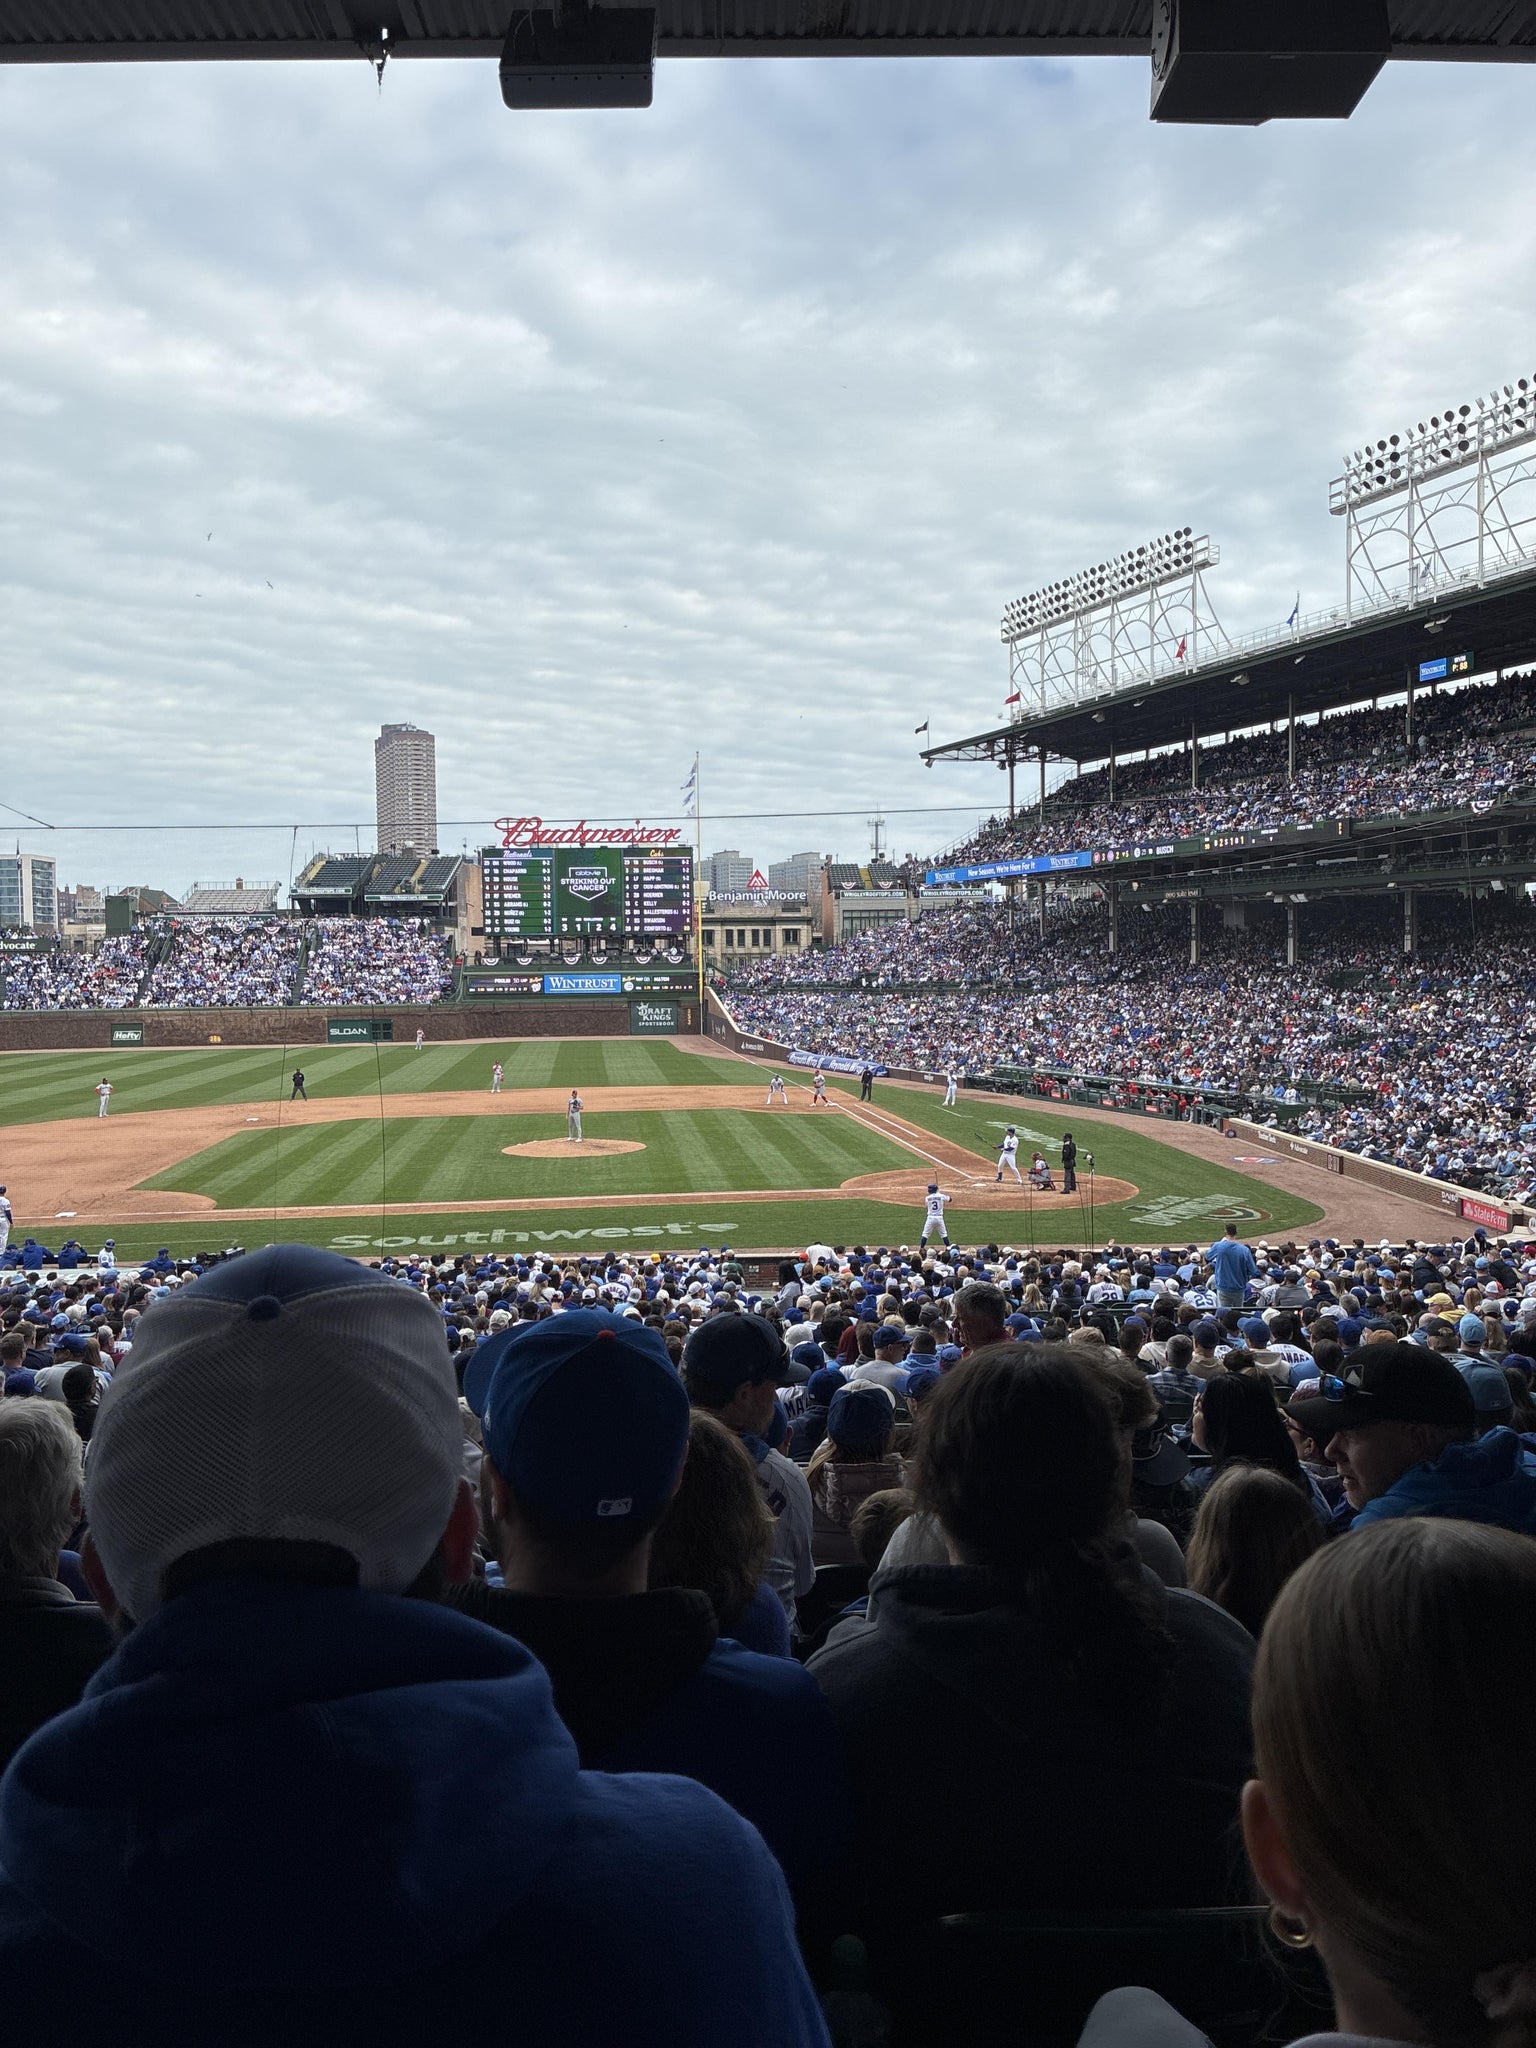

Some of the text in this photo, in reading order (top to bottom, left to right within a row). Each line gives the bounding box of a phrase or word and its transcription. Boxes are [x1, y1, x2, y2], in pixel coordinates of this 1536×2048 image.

[494, 816, 681, 846] Budweiser
[503, 849, 533, 858] Nationals
[650, 849, 664, 857] Cubs
[1156, 845, 1174, 855] BUSCH
[1050, 857, 1078, 866] WINTRUST
[968, 869, 977, 877] New
[979, 868, 995, 876] Season,
[996, 865, 1009, 873] We're
[1022, 862, 1031, 870] For
[709, 890, 807, 904] Benjamin Moore
[561, 923, 568, 932] 3
[596, 923, 602, 932] 2
[610, 923, 617, 931] 4
[0, 941, 36, 950] dvocate
[549, 976, 618, 989] WINTRUST
[639, 1008, 673, 1016] DRAFT
[115, 1032, 140, 1040] Hefty
[829, 1060, 851, 1071] Reynolds
[1474, 1205, 1508, 1228] State Farm
[326, 1222, 694, 1249] Southwest
[1194, 1294, 1214, 1307] 25
